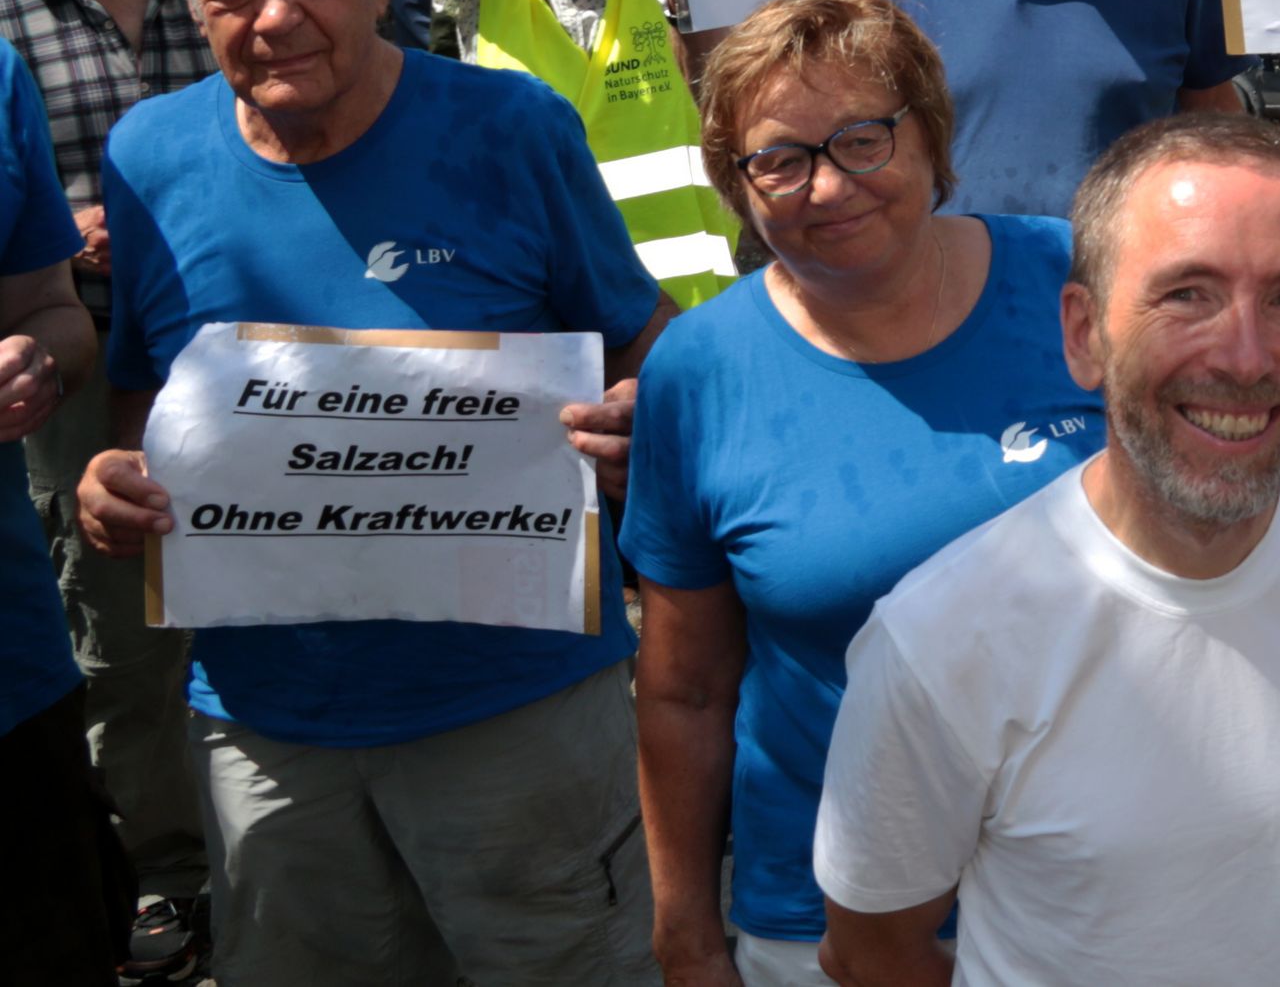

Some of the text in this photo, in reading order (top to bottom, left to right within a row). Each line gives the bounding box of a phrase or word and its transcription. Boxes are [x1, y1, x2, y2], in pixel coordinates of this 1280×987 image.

[605, 69, 668, 89] Naturschutz
[608, 94, 617, 103] in
[620, 86, 656, 100] Bayern
[416, 249, 455, 264] LBV
[237, 379, 520, 416] Für eine freie
[1049, 415, 1086, 438] LBV
[288, 443, 474, 471] Salzach!
[191, 504, 572, 534] Ohne Kraftwerke!
